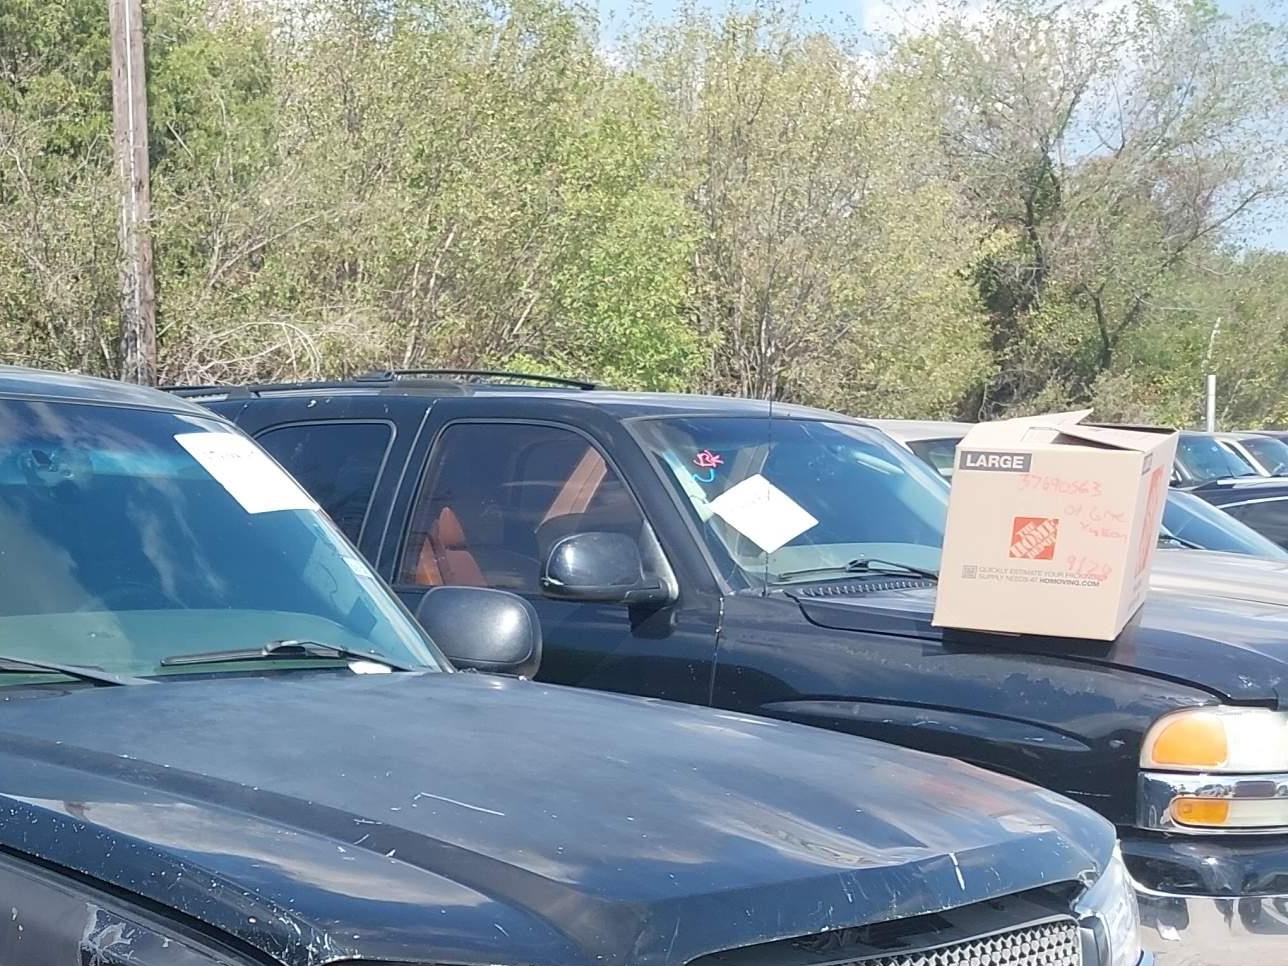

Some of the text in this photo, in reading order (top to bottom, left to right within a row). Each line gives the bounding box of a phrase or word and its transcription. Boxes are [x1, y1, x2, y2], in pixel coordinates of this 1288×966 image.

[965, 453, 1025, 469] LARGE
[1010, 520, 1056, 558] HOME
[979, 567, 1008, 575] QUICKLY
[1009, 568, 1043, 577] ESTIMATE
[979, 573, 1004, 581] SUPPLY
